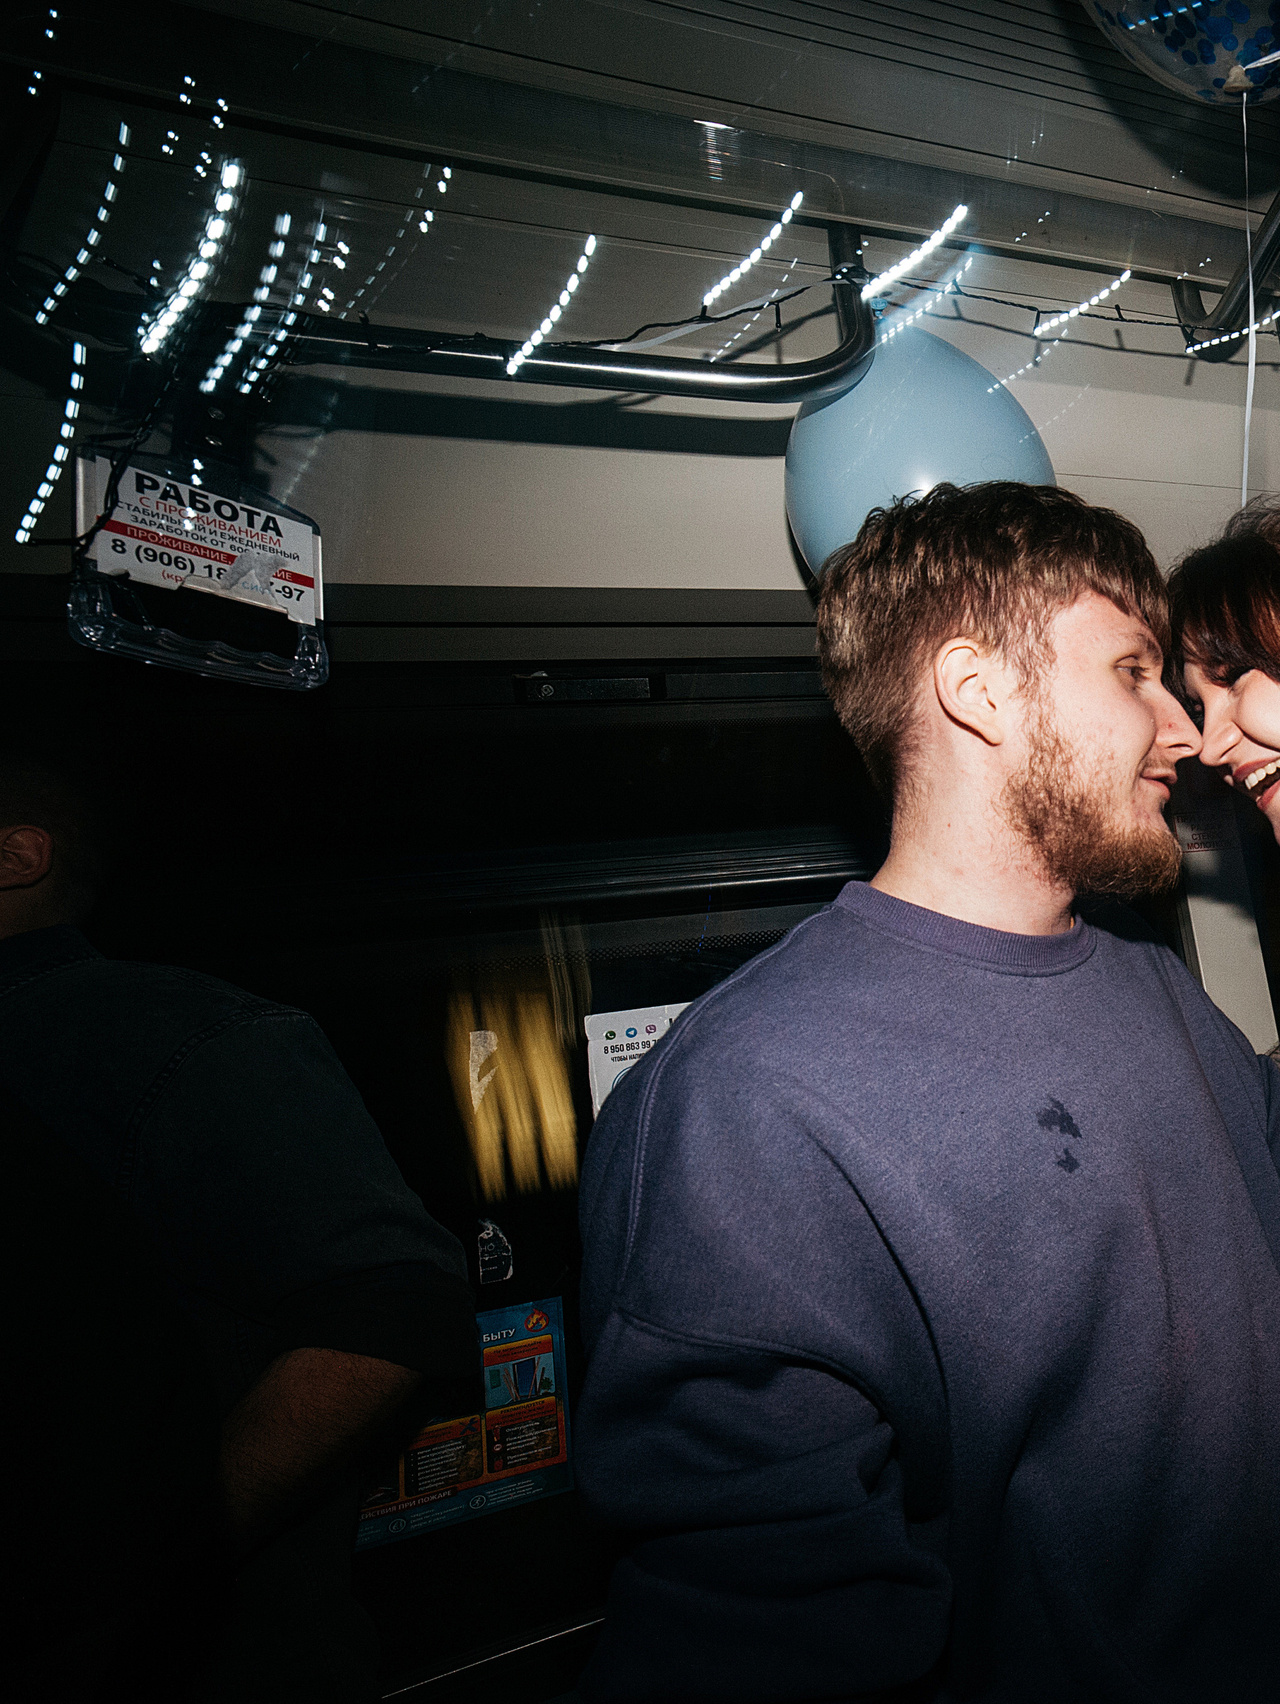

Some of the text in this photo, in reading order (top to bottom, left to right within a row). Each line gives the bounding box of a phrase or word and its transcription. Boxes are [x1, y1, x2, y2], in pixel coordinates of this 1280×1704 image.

[135, 472, 284, 539] РАБОТА
[138, 496, 282, 548] С ПРОЖИВАНИЕМ
[126, 526, 232, 566] ПРОЖИВАНИЕ,
[130, 514, 208, 544] ЗАРАБОТОК
[210, 538, 227, 549] ОТ
[208, 527, 218, 537] И
[219, 531, 300, 562] ЕЖЕДНЕВНЫЙ
[111, 538, 127, 555] 8
[134, 544, 195, 574] (906)
[603, 1045, 609, 1055] 8
[610, 1043, 625, 1054] 950
[626, 1041, 640, 1052] 863
[641, 1040, 651, 1049] 99
[482, 1328, 517, 1343] БЫТУ
[398, 1501, 417, 1512] ПРИ
[418, 1490, 453, 1507] ПОЖАРЕ
